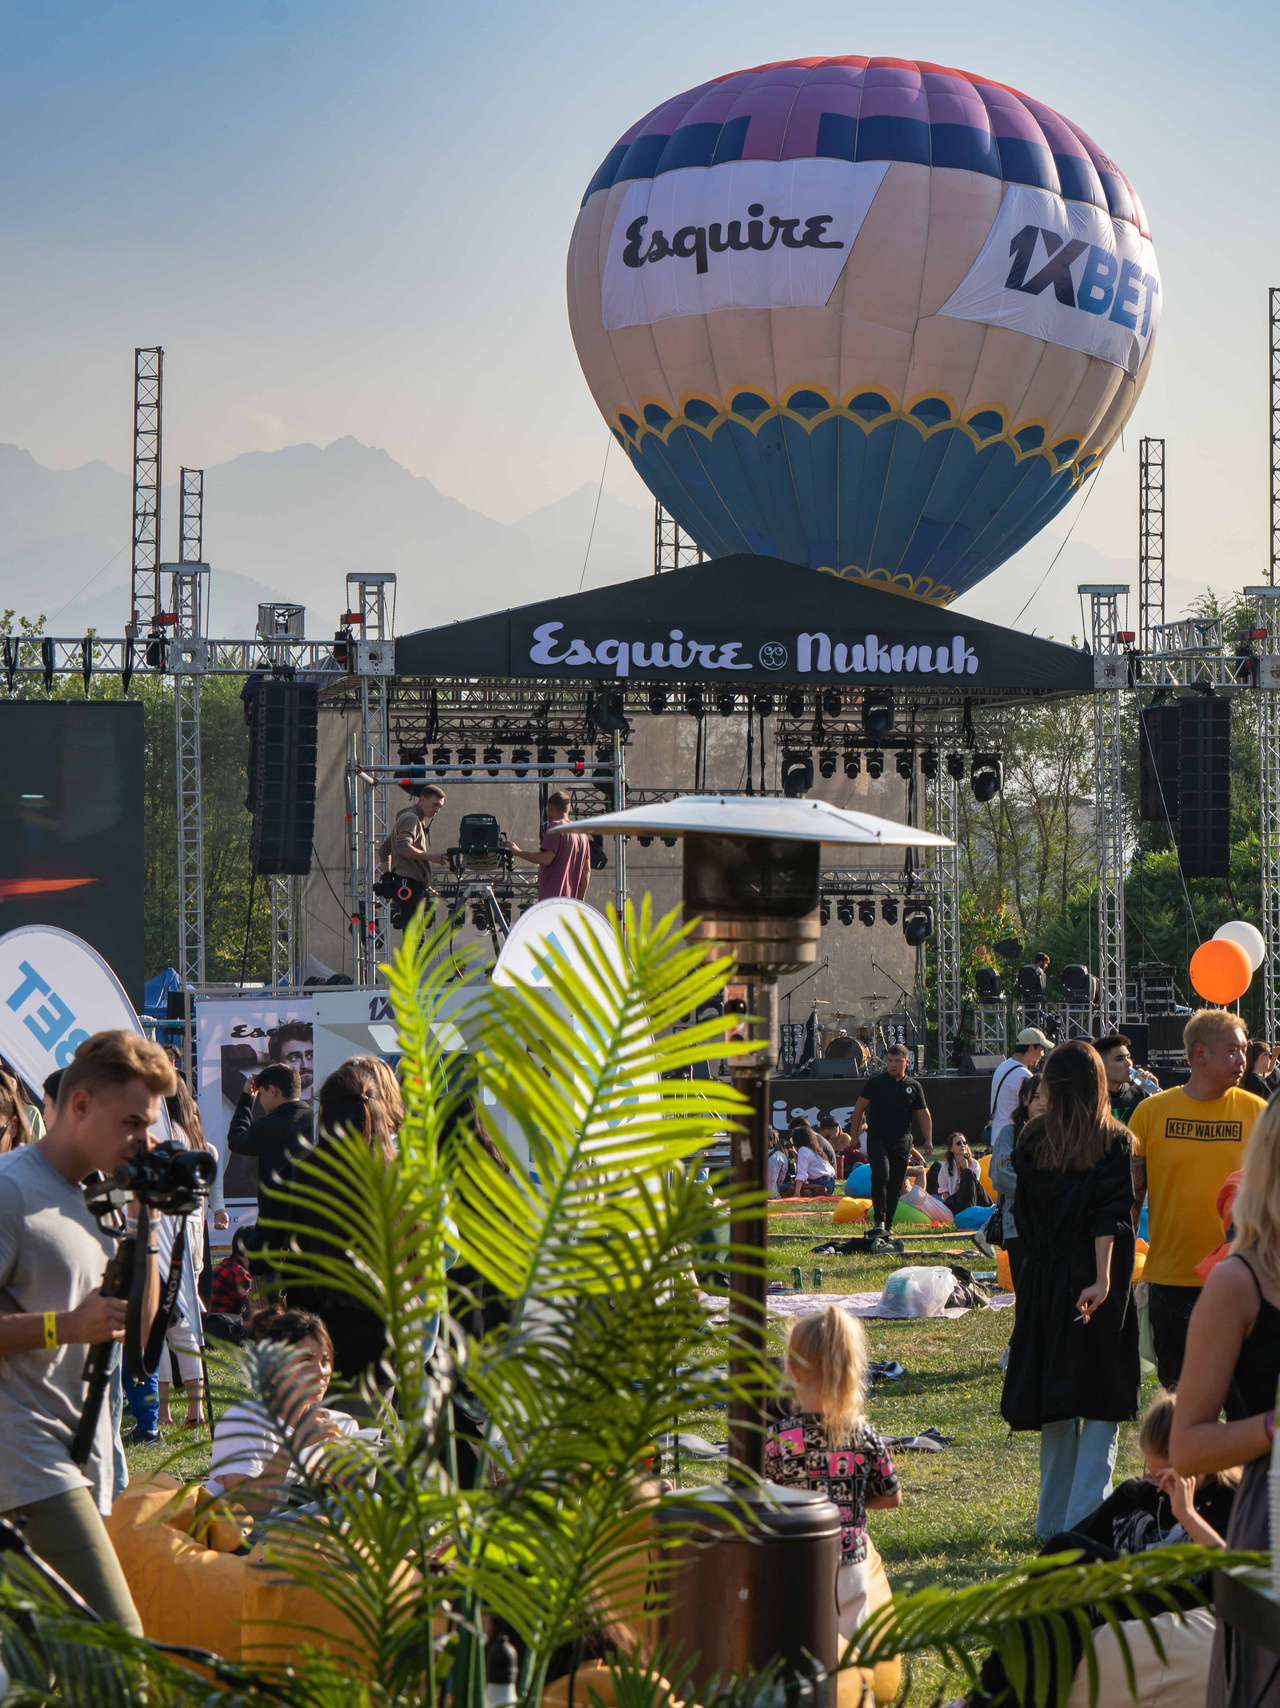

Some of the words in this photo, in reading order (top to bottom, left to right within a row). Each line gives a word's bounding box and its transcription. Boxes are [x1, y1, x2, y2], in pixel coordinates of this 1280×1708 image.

[622, 203, 845, 274] Esquire
[1004, 224, 1159, 338] 1XBET
[529, 622, 753, 677] Esquire
[1169, 1121, 1194, 1136] KEEP
[1195, 1123, 1239, 1138] WALKING
[162, 1269, 180, 1314] SONY
